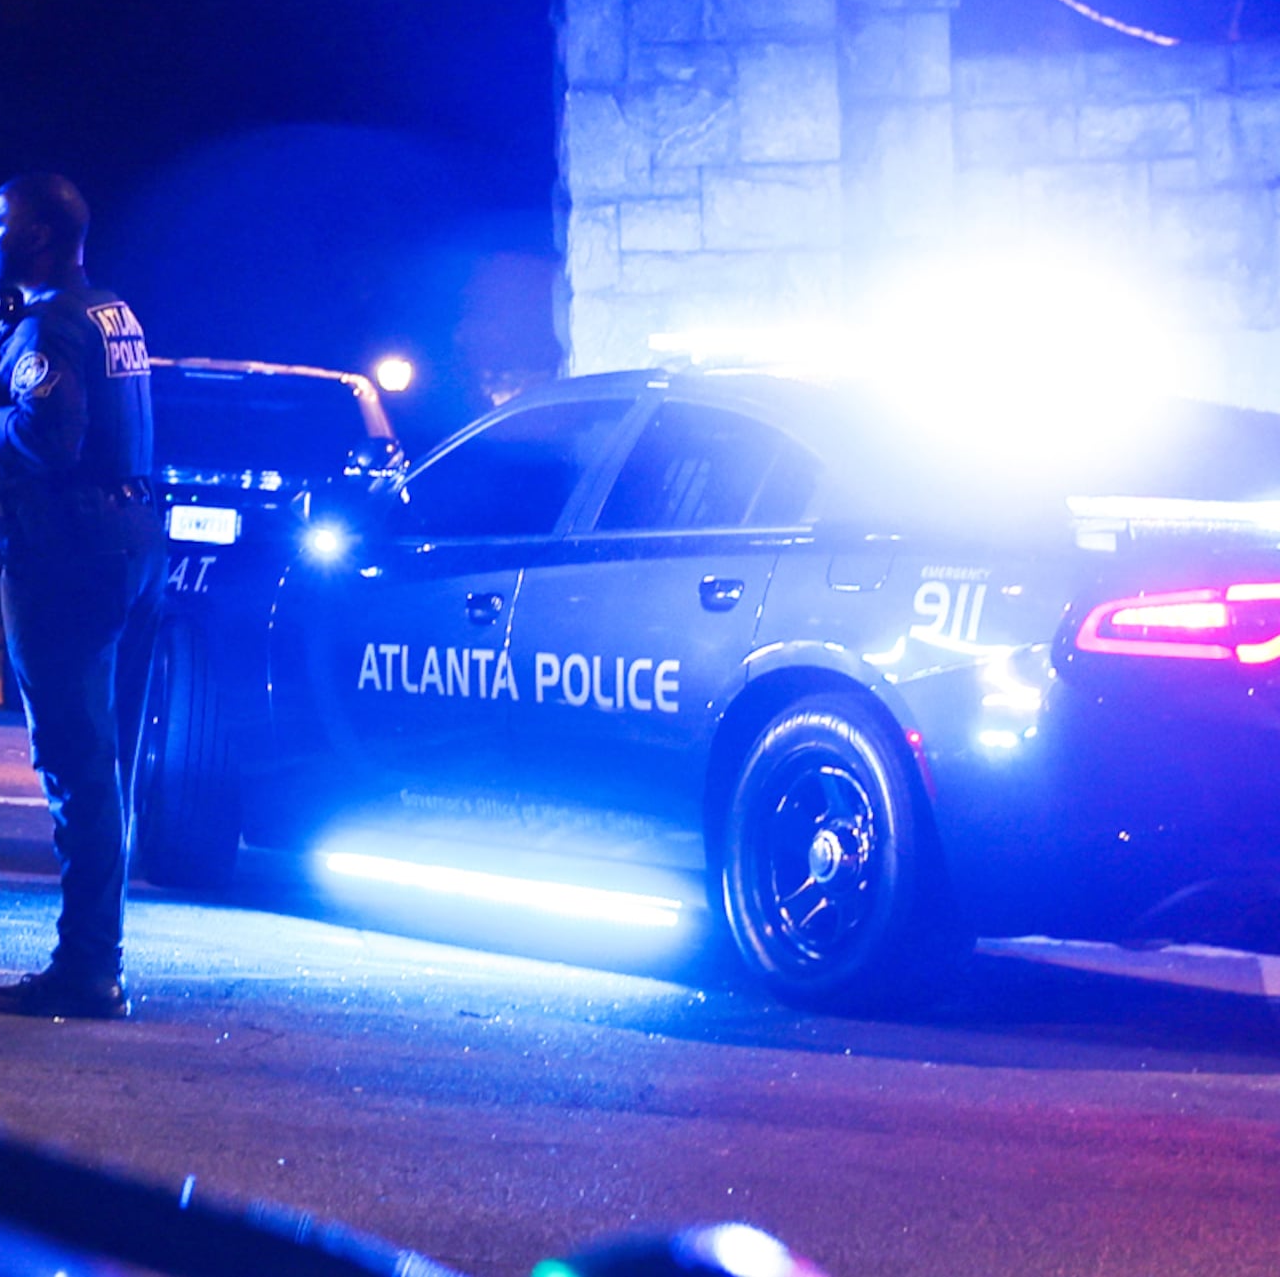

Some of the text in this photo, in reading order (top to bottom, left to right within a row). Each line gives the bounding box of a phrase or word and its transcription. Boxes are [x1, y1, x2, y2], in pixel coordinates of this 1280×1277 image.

[109, 339, 151, 372] POLIC
[909, 580, 988, 642] 911
[357, 642, 680, 713] ATLANTA POLICE
